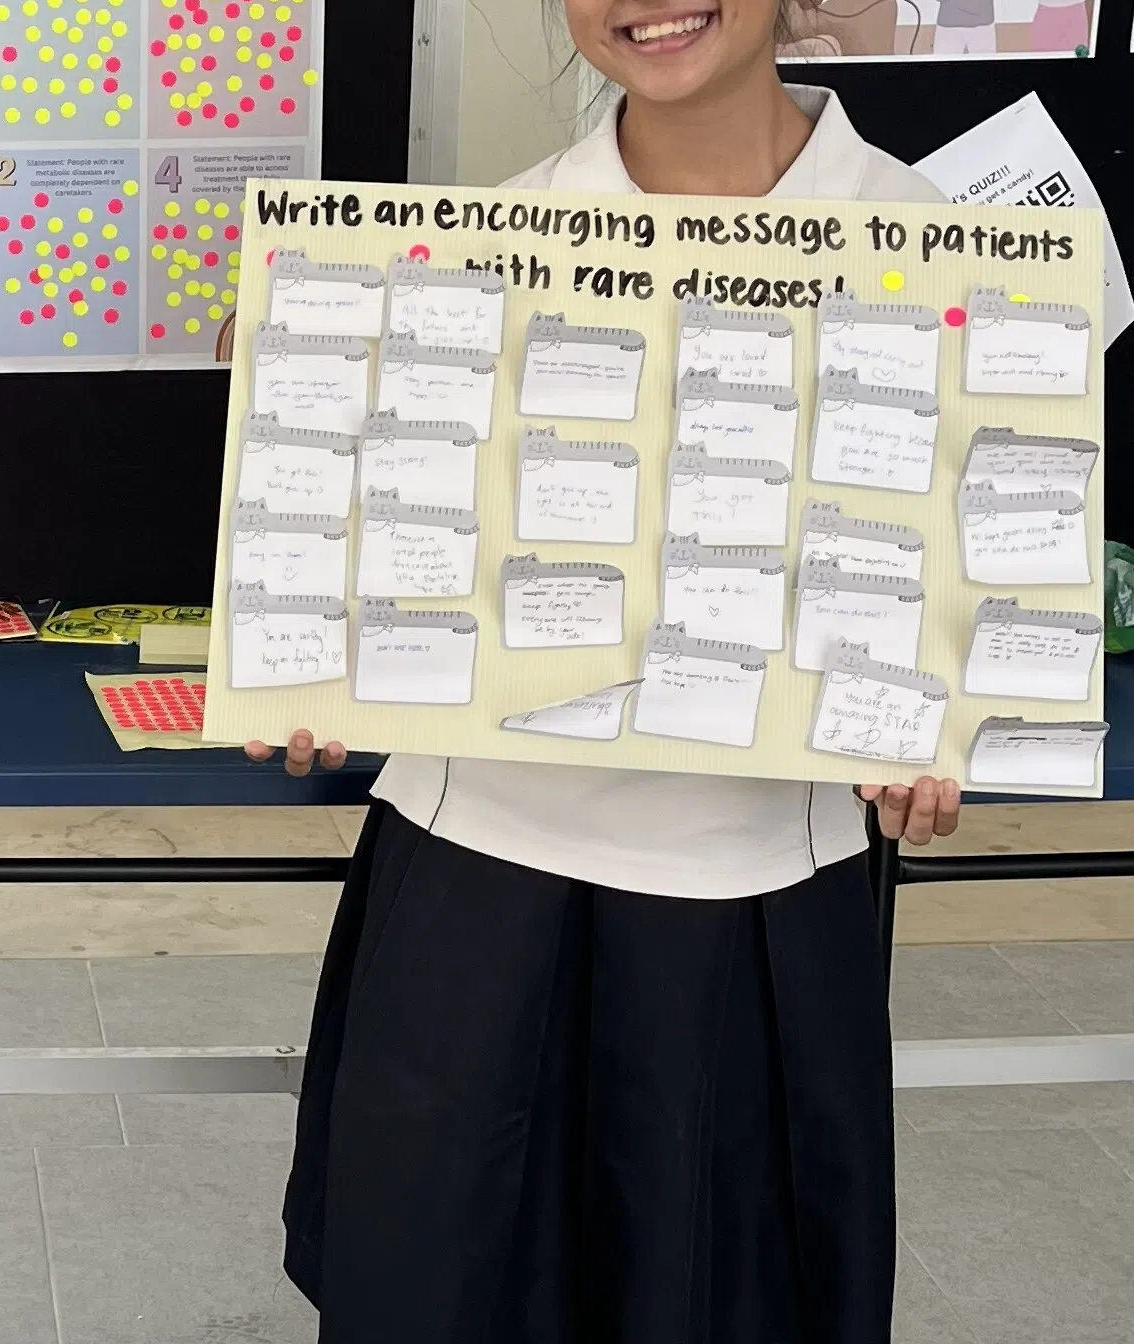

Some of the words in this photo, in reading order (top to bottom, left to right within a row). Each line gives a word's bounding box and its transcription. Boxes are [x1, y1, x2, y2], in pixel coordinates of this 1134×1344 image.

[155, 156, 182, 193] 4
[969, 165, 1011, 195] QUIZ!!!
[986, 191, 1000, 203] get
[1007, 168, 1034, 189] candy!
[257, 190, 363, 227] Write
[374, 198, 423, 227] an
[434, 198, 655, 248] encourging
[676, 212, 846, 255] message
[866, 215, 906, 252] to
[922, 223, 1073, 262] patients
[573, 264, 654, 300] rare
